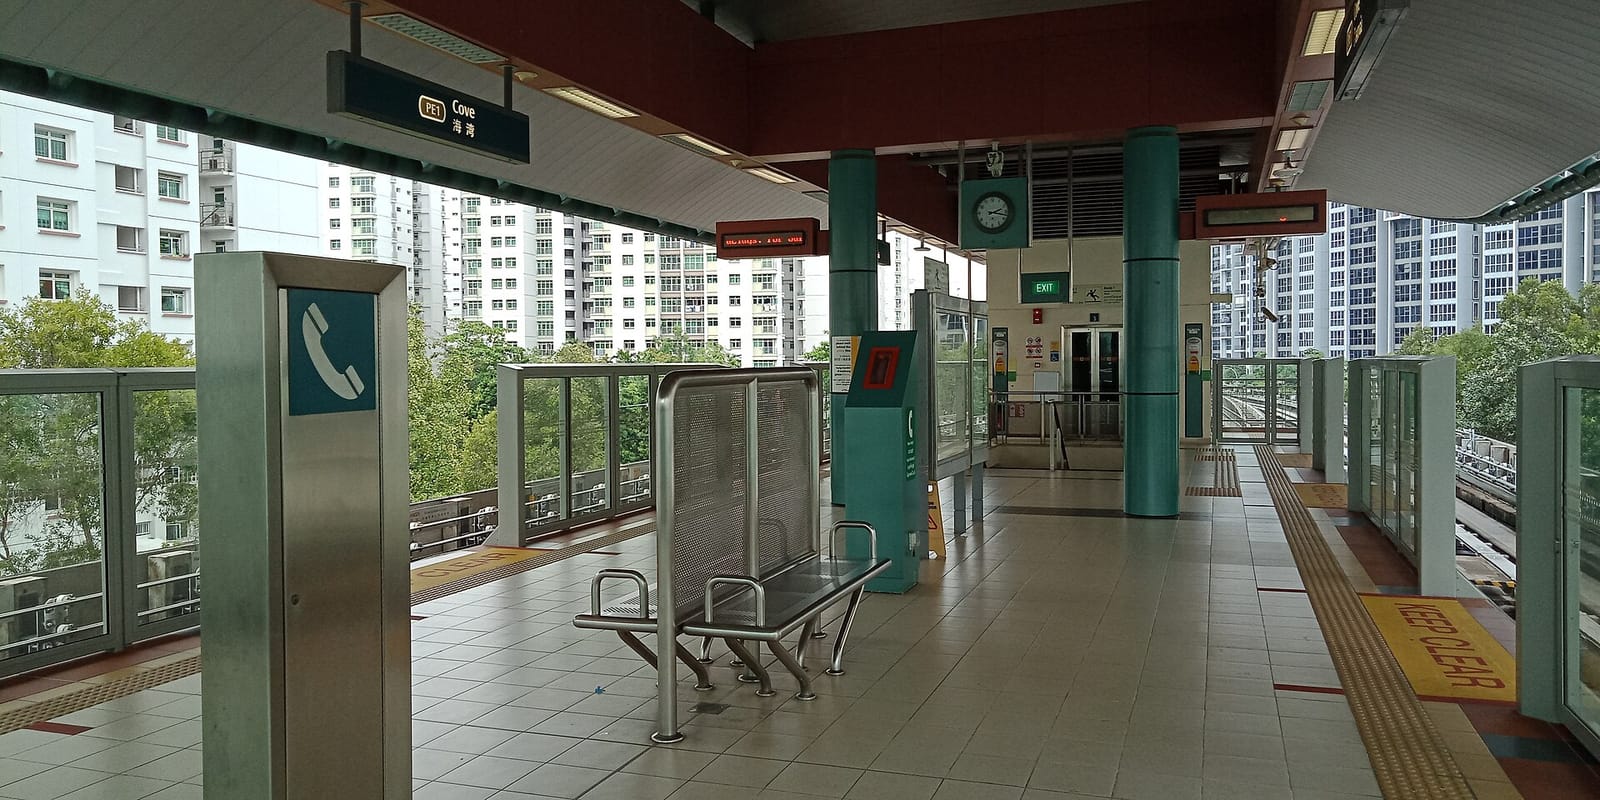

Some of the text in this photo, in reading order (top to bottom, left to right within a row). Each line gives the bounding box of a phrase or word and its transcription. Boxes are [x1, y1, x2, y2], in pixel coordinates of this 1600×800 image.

[426, 99, 476, 119] PE1 Cove
[452, 118, 475, 138] 海湾
[1036, 283, 1053, 293] EXIT
[417, 552, 517, 577] CLEAR
[1394, 602, 1506, 689] KEEP CLEAR
